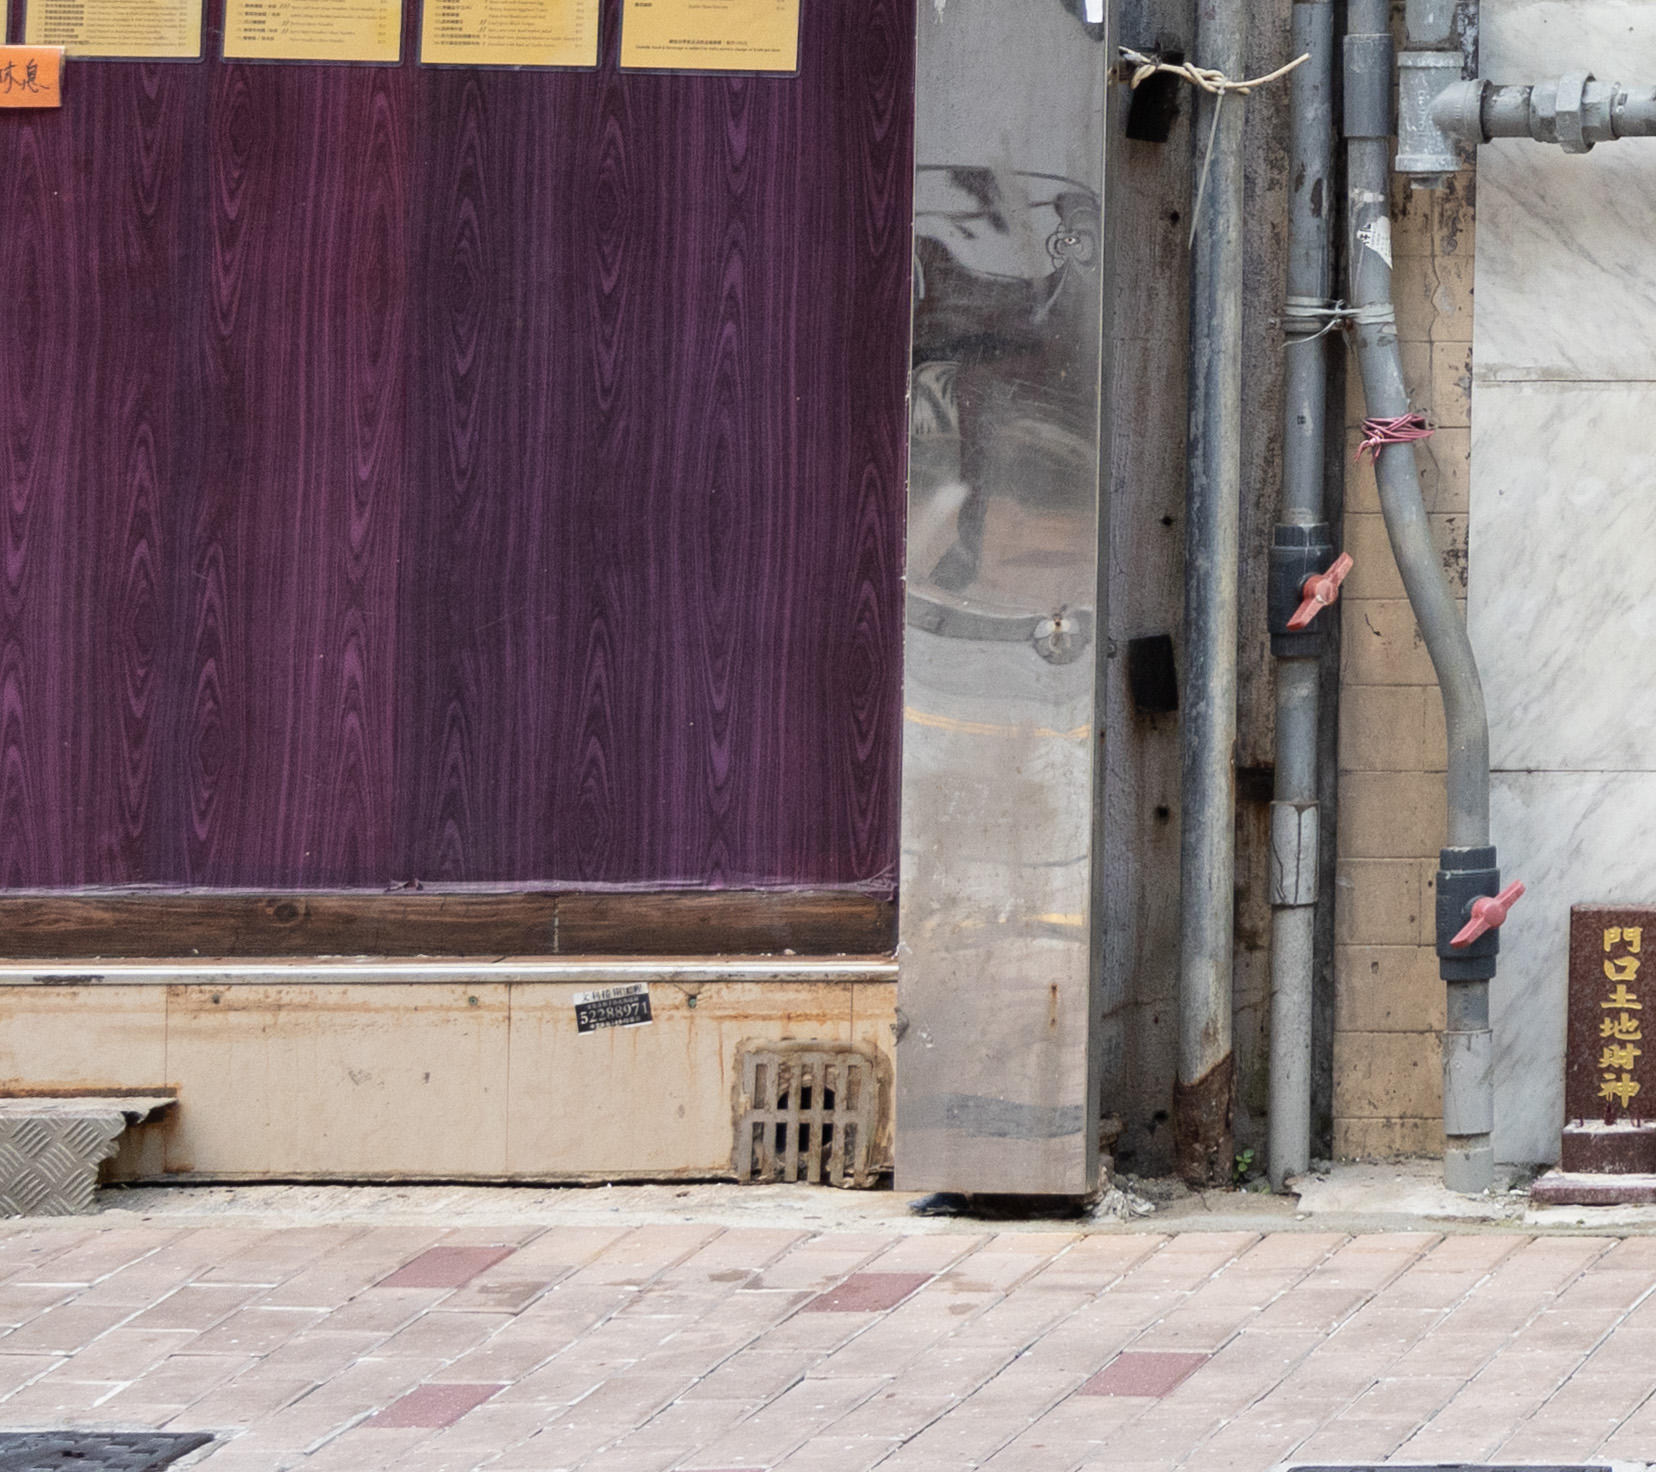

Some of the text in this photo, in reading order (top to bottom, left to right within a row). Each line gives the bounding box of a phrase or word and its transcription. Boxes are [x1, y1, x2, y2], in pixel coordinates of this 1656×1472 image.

[1597, 924, 1644, 1109] 門口土地財神
